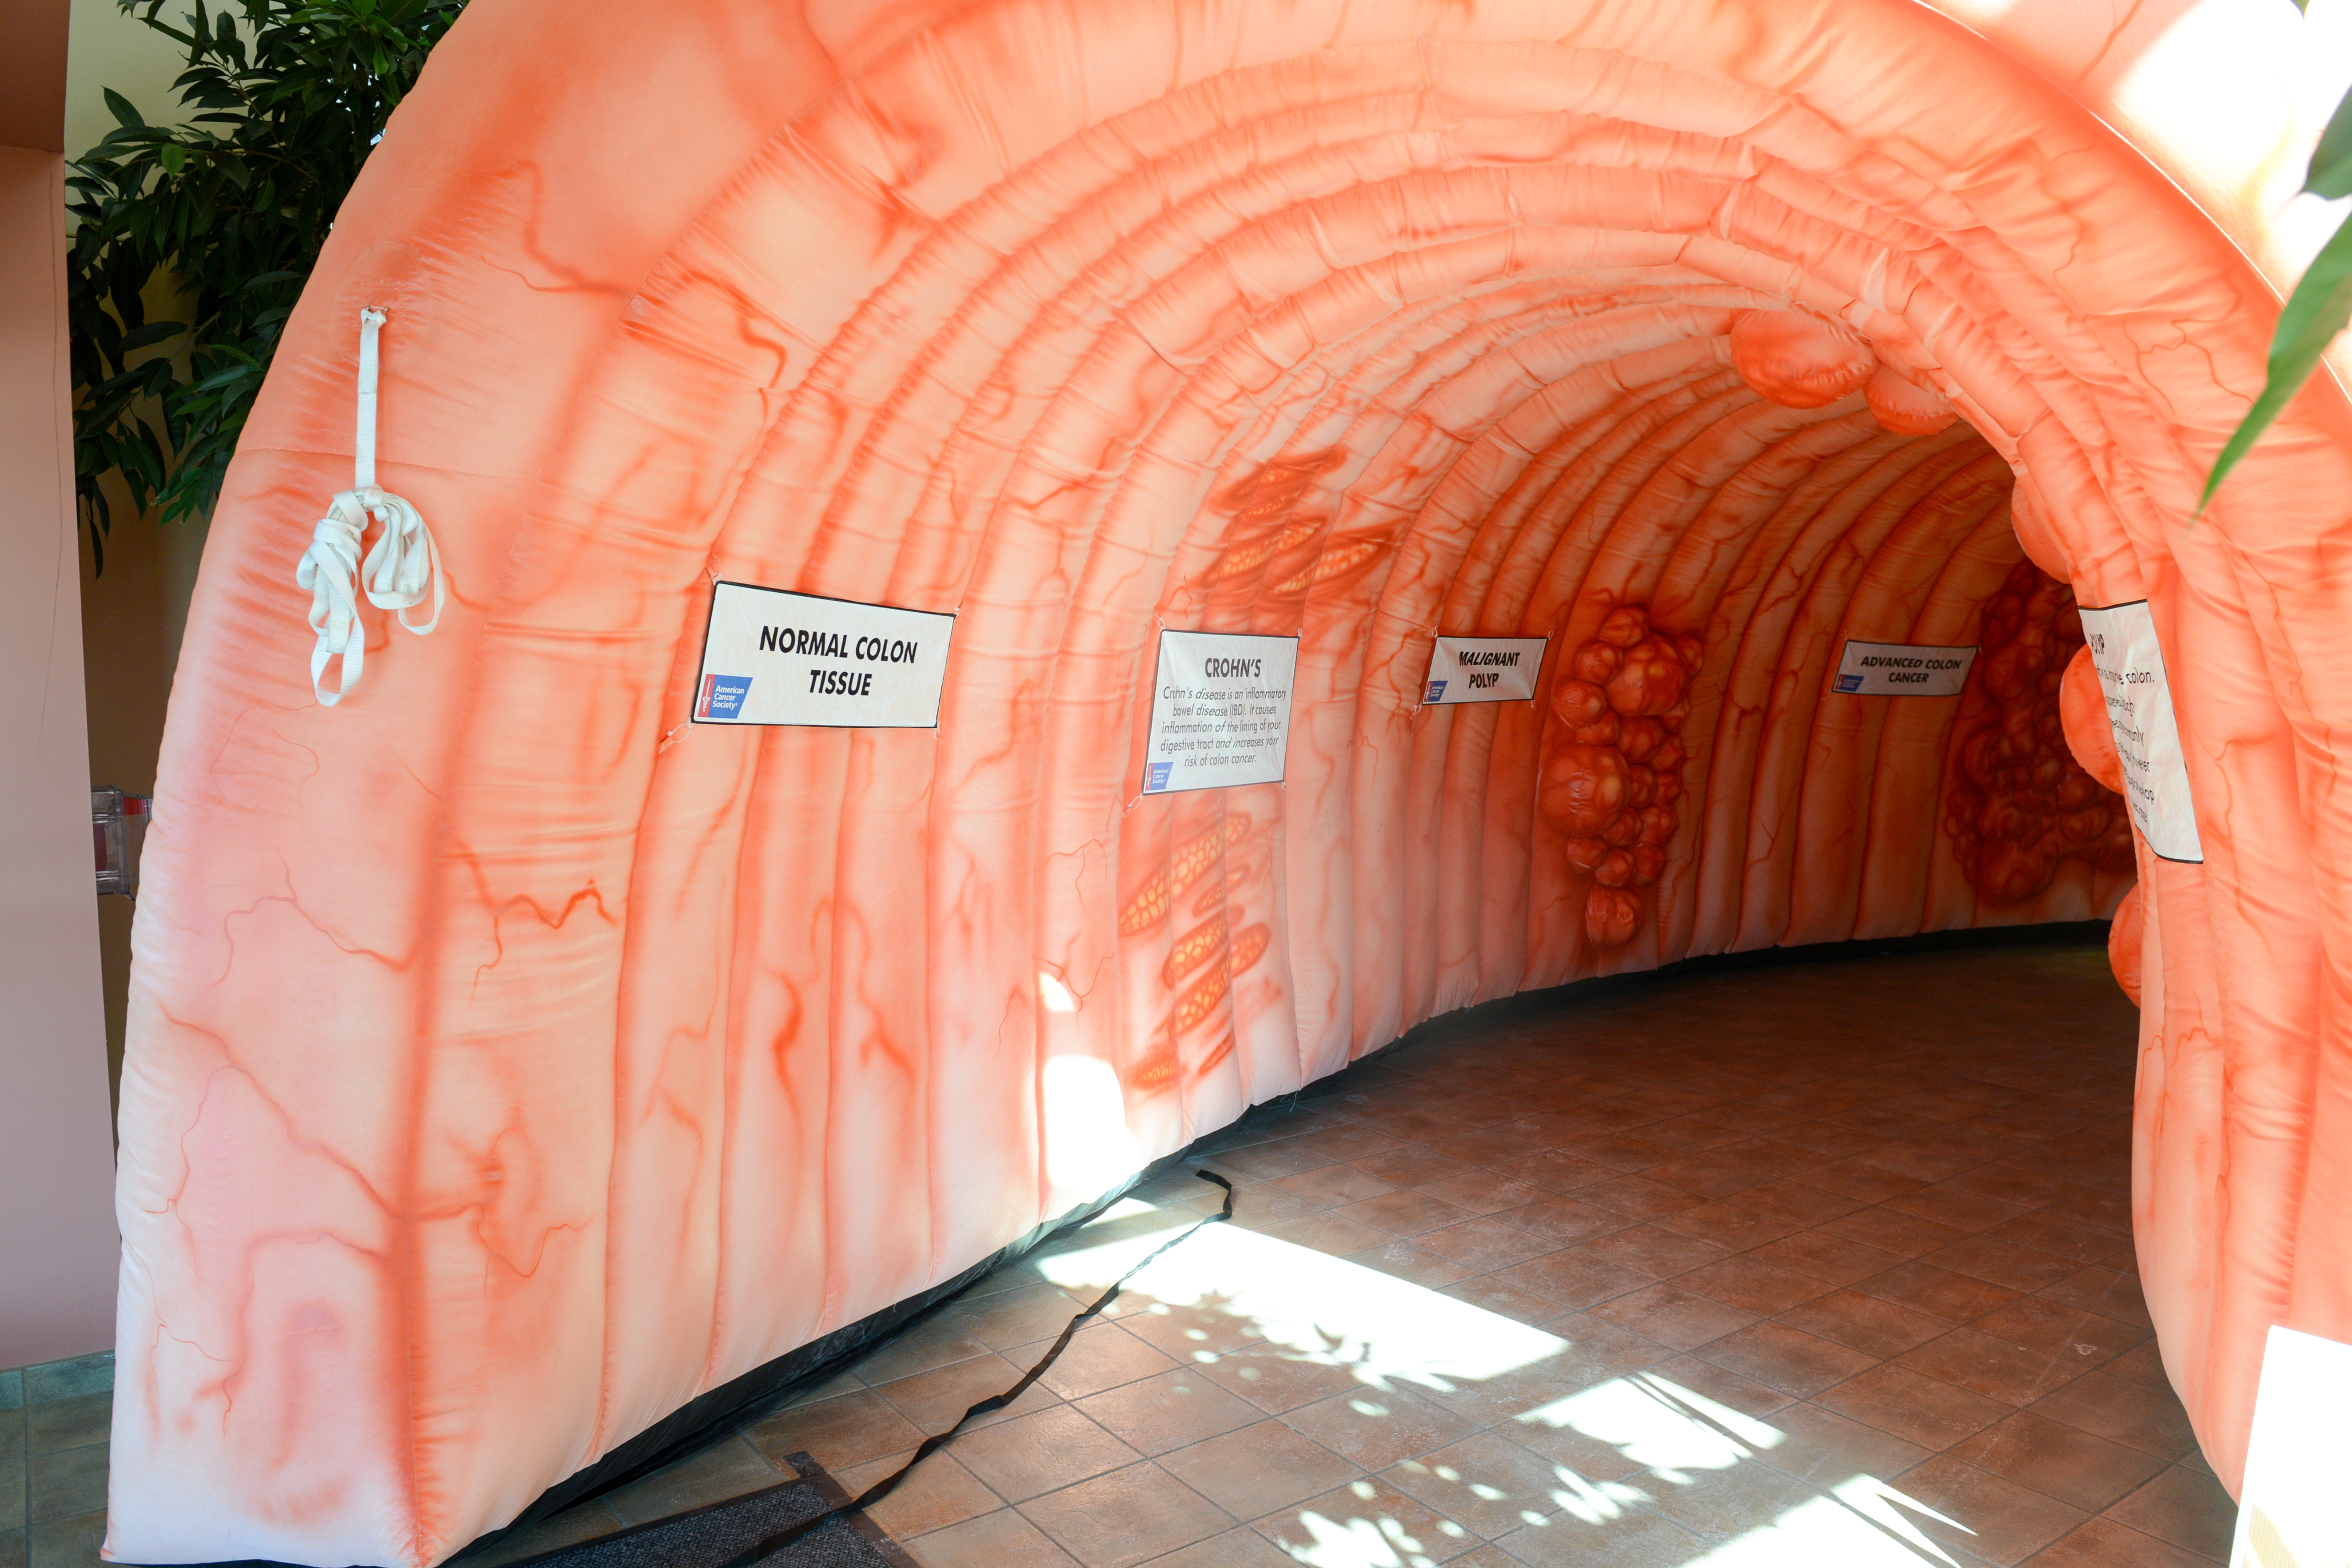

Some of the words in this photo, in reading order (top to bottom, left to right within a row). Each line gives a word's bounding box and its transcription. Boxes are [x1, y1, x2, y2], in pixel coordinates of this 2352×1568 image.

[759, 626, 848, 658] NORMAL
[855, 636, 918, 663] COLON
[1459, 651, 1520, 666] MALIGNANT
[1860, 656, 1923, 667] ADVANCED
[1925, 659, 1962, 670] COLON
[1205, 658, 1261, 678] CROHN'S
[2126, 666, 2154, 684] colon.
[809, 670, 872, 696] TISSUE
[1468, 673, 1499, 689] POLYP
[1888, 672, 1929, 682] CANCER
[715, 685, 745, 694] American
[1164, 686, 1192, 699] Crohn's
[1196, 687, 1226, 700] disease
[1228, 688, 1232, 699] is
[1234, 690, 1243, 699] an
[1245, 687, 1287, 701] inflammatory
[1173, 703, 1194, 716] bowel
[1196, 703, 1228, 716] disease
[1230, 704, 1247, 719] (IBD).
[1249, 704, 1254, 714] It
[1256, 706, 1276, 714] causes
[1162, 721, 1212, 734] inflammation
[1215, 721, 1226, 732] of
[1227, 720, 1238, 732] the
[1240, 720, 1257, 734] lining
[1260, 718, 1266, 730] of
[1268, 721, 1281, 733] your
[1160, 738, 1195, 754] digestive
[1197, 738, 1213, 749] tract
[1216, 736, 1232, 748] and
[1233, 737, 1264, 748] increases
[1265, 737, 1279, 749] your
[1184, 754, 1197, 767] risk
[1200, 753, 1208, 766] of
[1209, 752, 1229, 765] colon
[1232, 754, 1257, 764] cancer.
